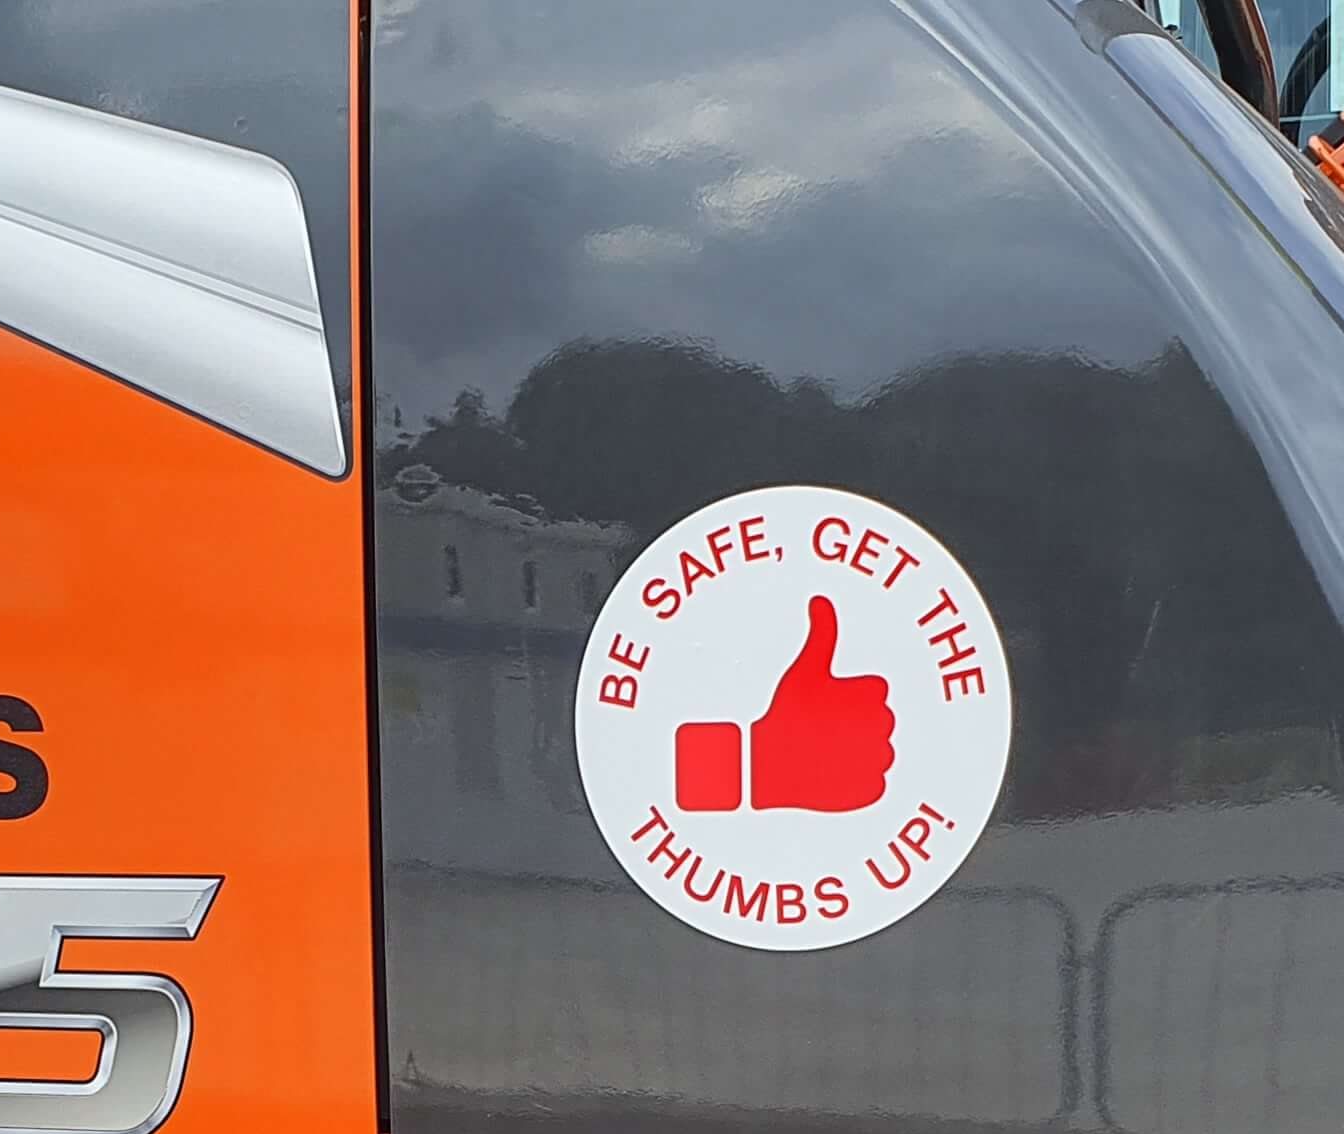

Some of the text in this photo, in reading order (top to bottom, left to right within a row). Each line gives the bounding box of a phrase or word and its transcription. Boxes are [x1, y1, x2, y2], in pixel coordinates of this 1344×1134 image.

[599, 516, 986, 709] BE SAFE, GET THE
[630, 802, 956, 925] THUMBS UP!
